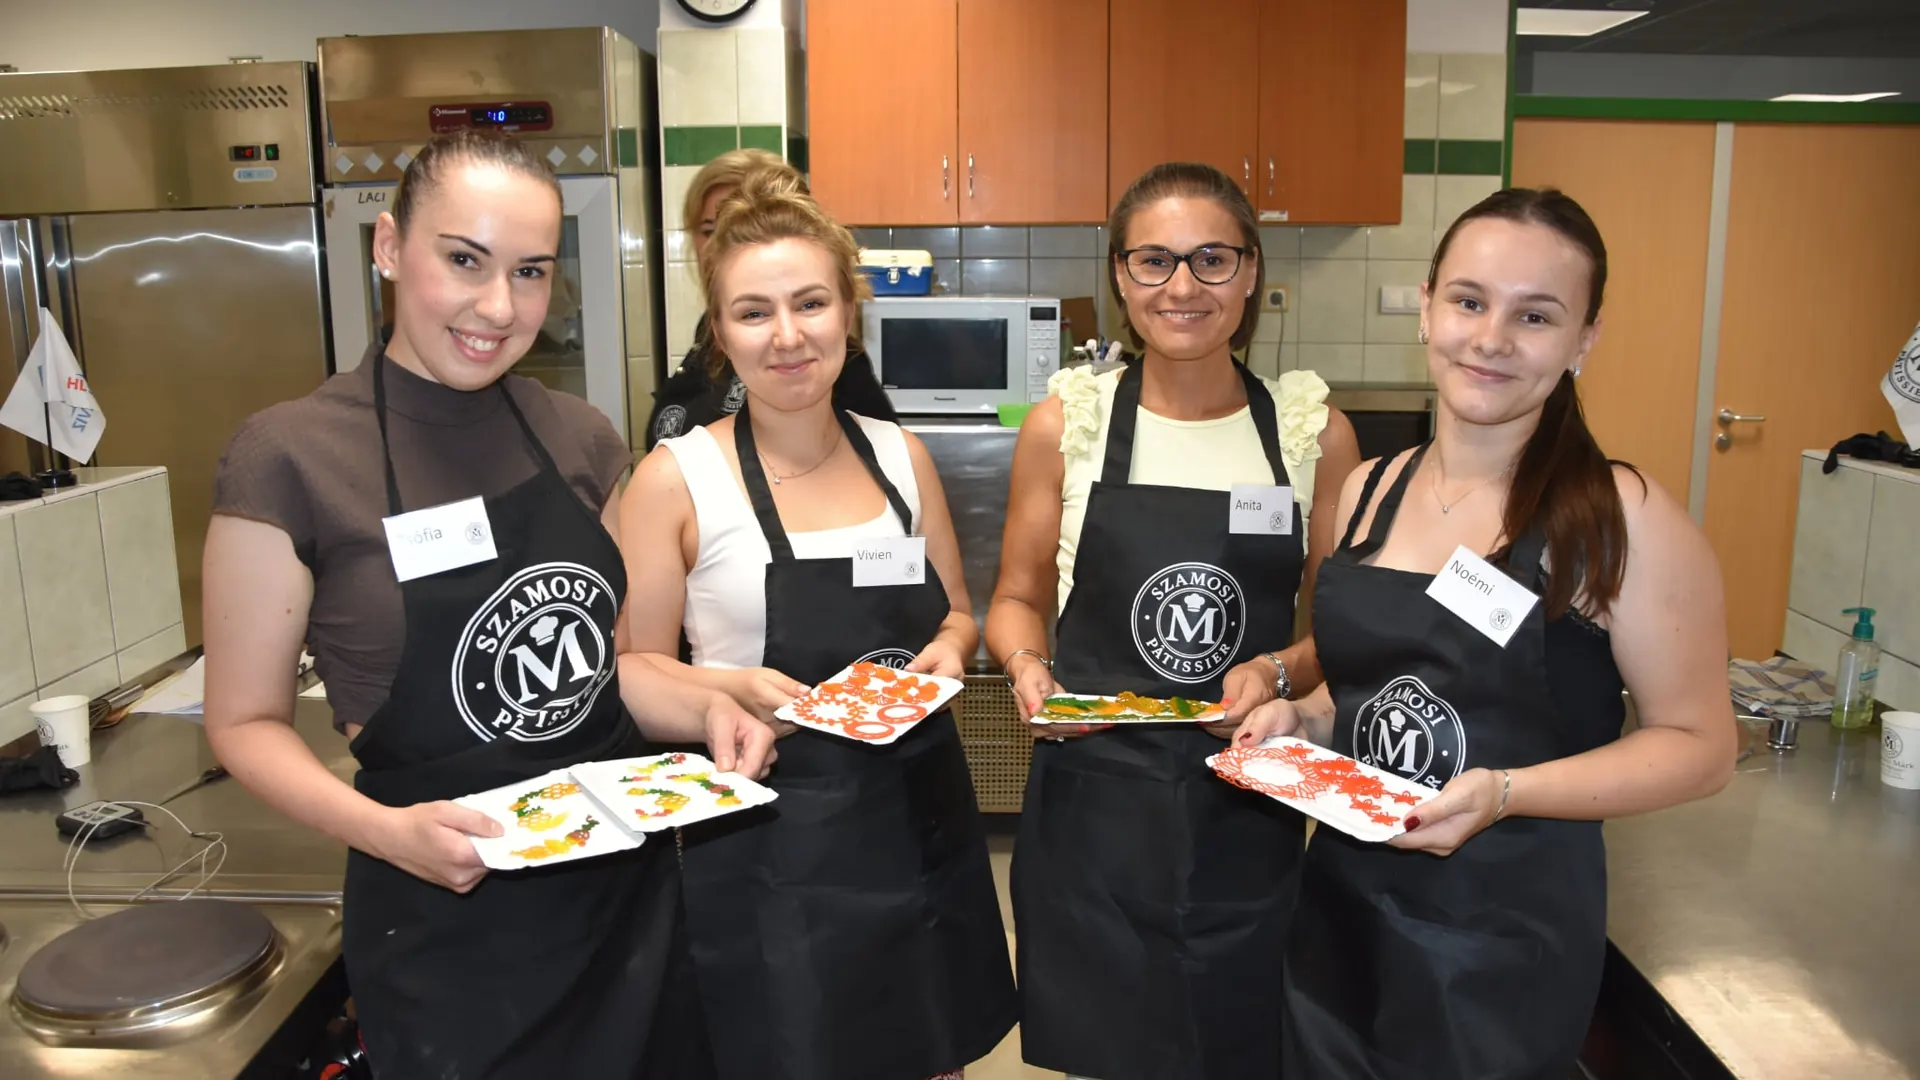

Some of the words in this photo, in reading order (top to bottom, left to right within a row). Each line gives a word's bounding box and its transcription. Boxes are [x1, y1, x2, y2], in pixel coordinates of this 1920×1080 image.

[1235, 499, 1262, 511] Anita
[857, 549, 892, 560] Vivien
[1151, 572, 1236, 604] SZAMOSI
[1450, 560, 1496, 596] Noémi
[476, 576, 600, 653] SZAMOSI
[1165, 604, 1219, 644] M
[509, 620, 595, 703] M
[1145, 637, 1231, 673] PÂTISSIER
[1373, 686, 1446, 727] SZAMOSI
[1375, 717, 1422, 773] M
